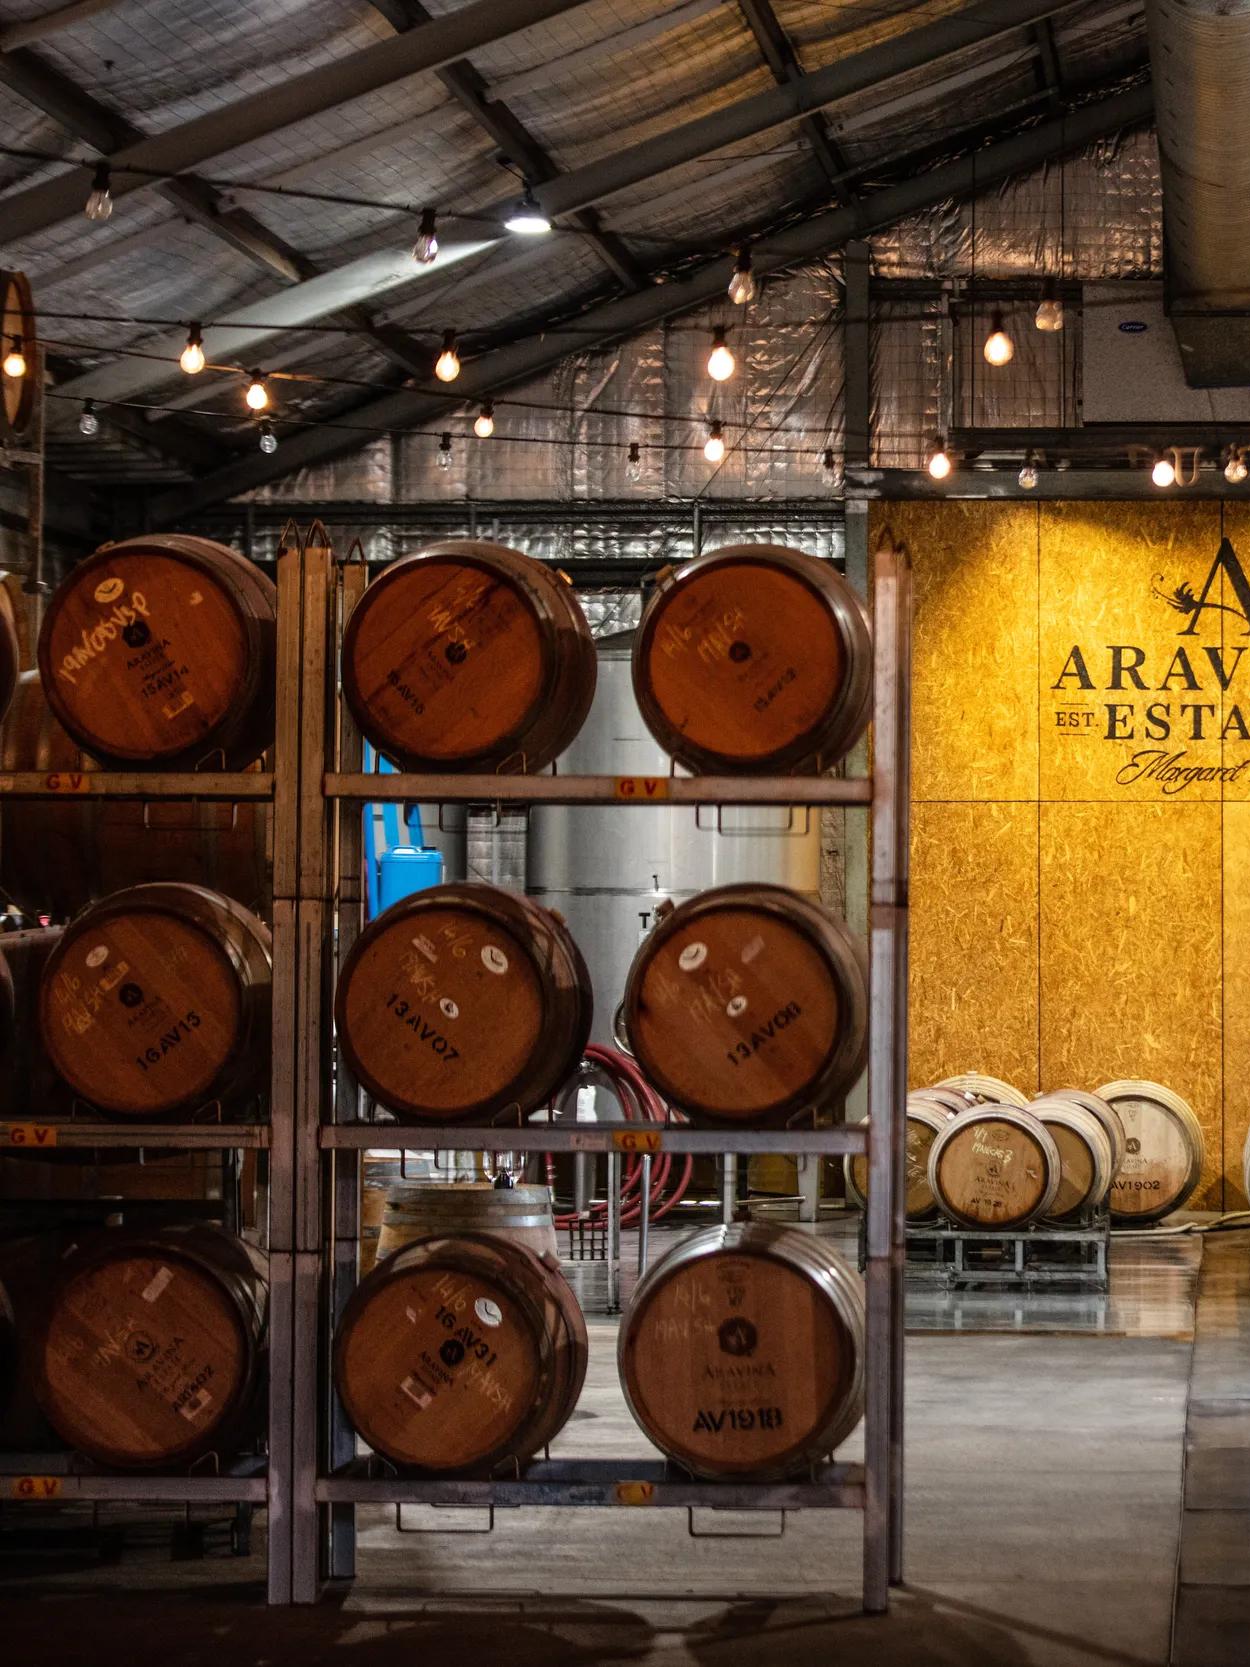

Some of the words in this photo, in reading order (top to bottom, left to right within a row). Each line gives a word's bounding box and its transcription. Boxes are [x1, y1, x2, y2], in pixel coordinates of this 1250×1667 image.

[1055, 710, 1099, 728] EST.
[1116, 750, 1250, 794] Margaret
[386, 993, 459, 1062] 13AV07
[726, 1000, 802, 1066] 13AV08
[1110, 1180, 1160, 1191] AV1902
[692, 1407, 783, 1433] AV1918
